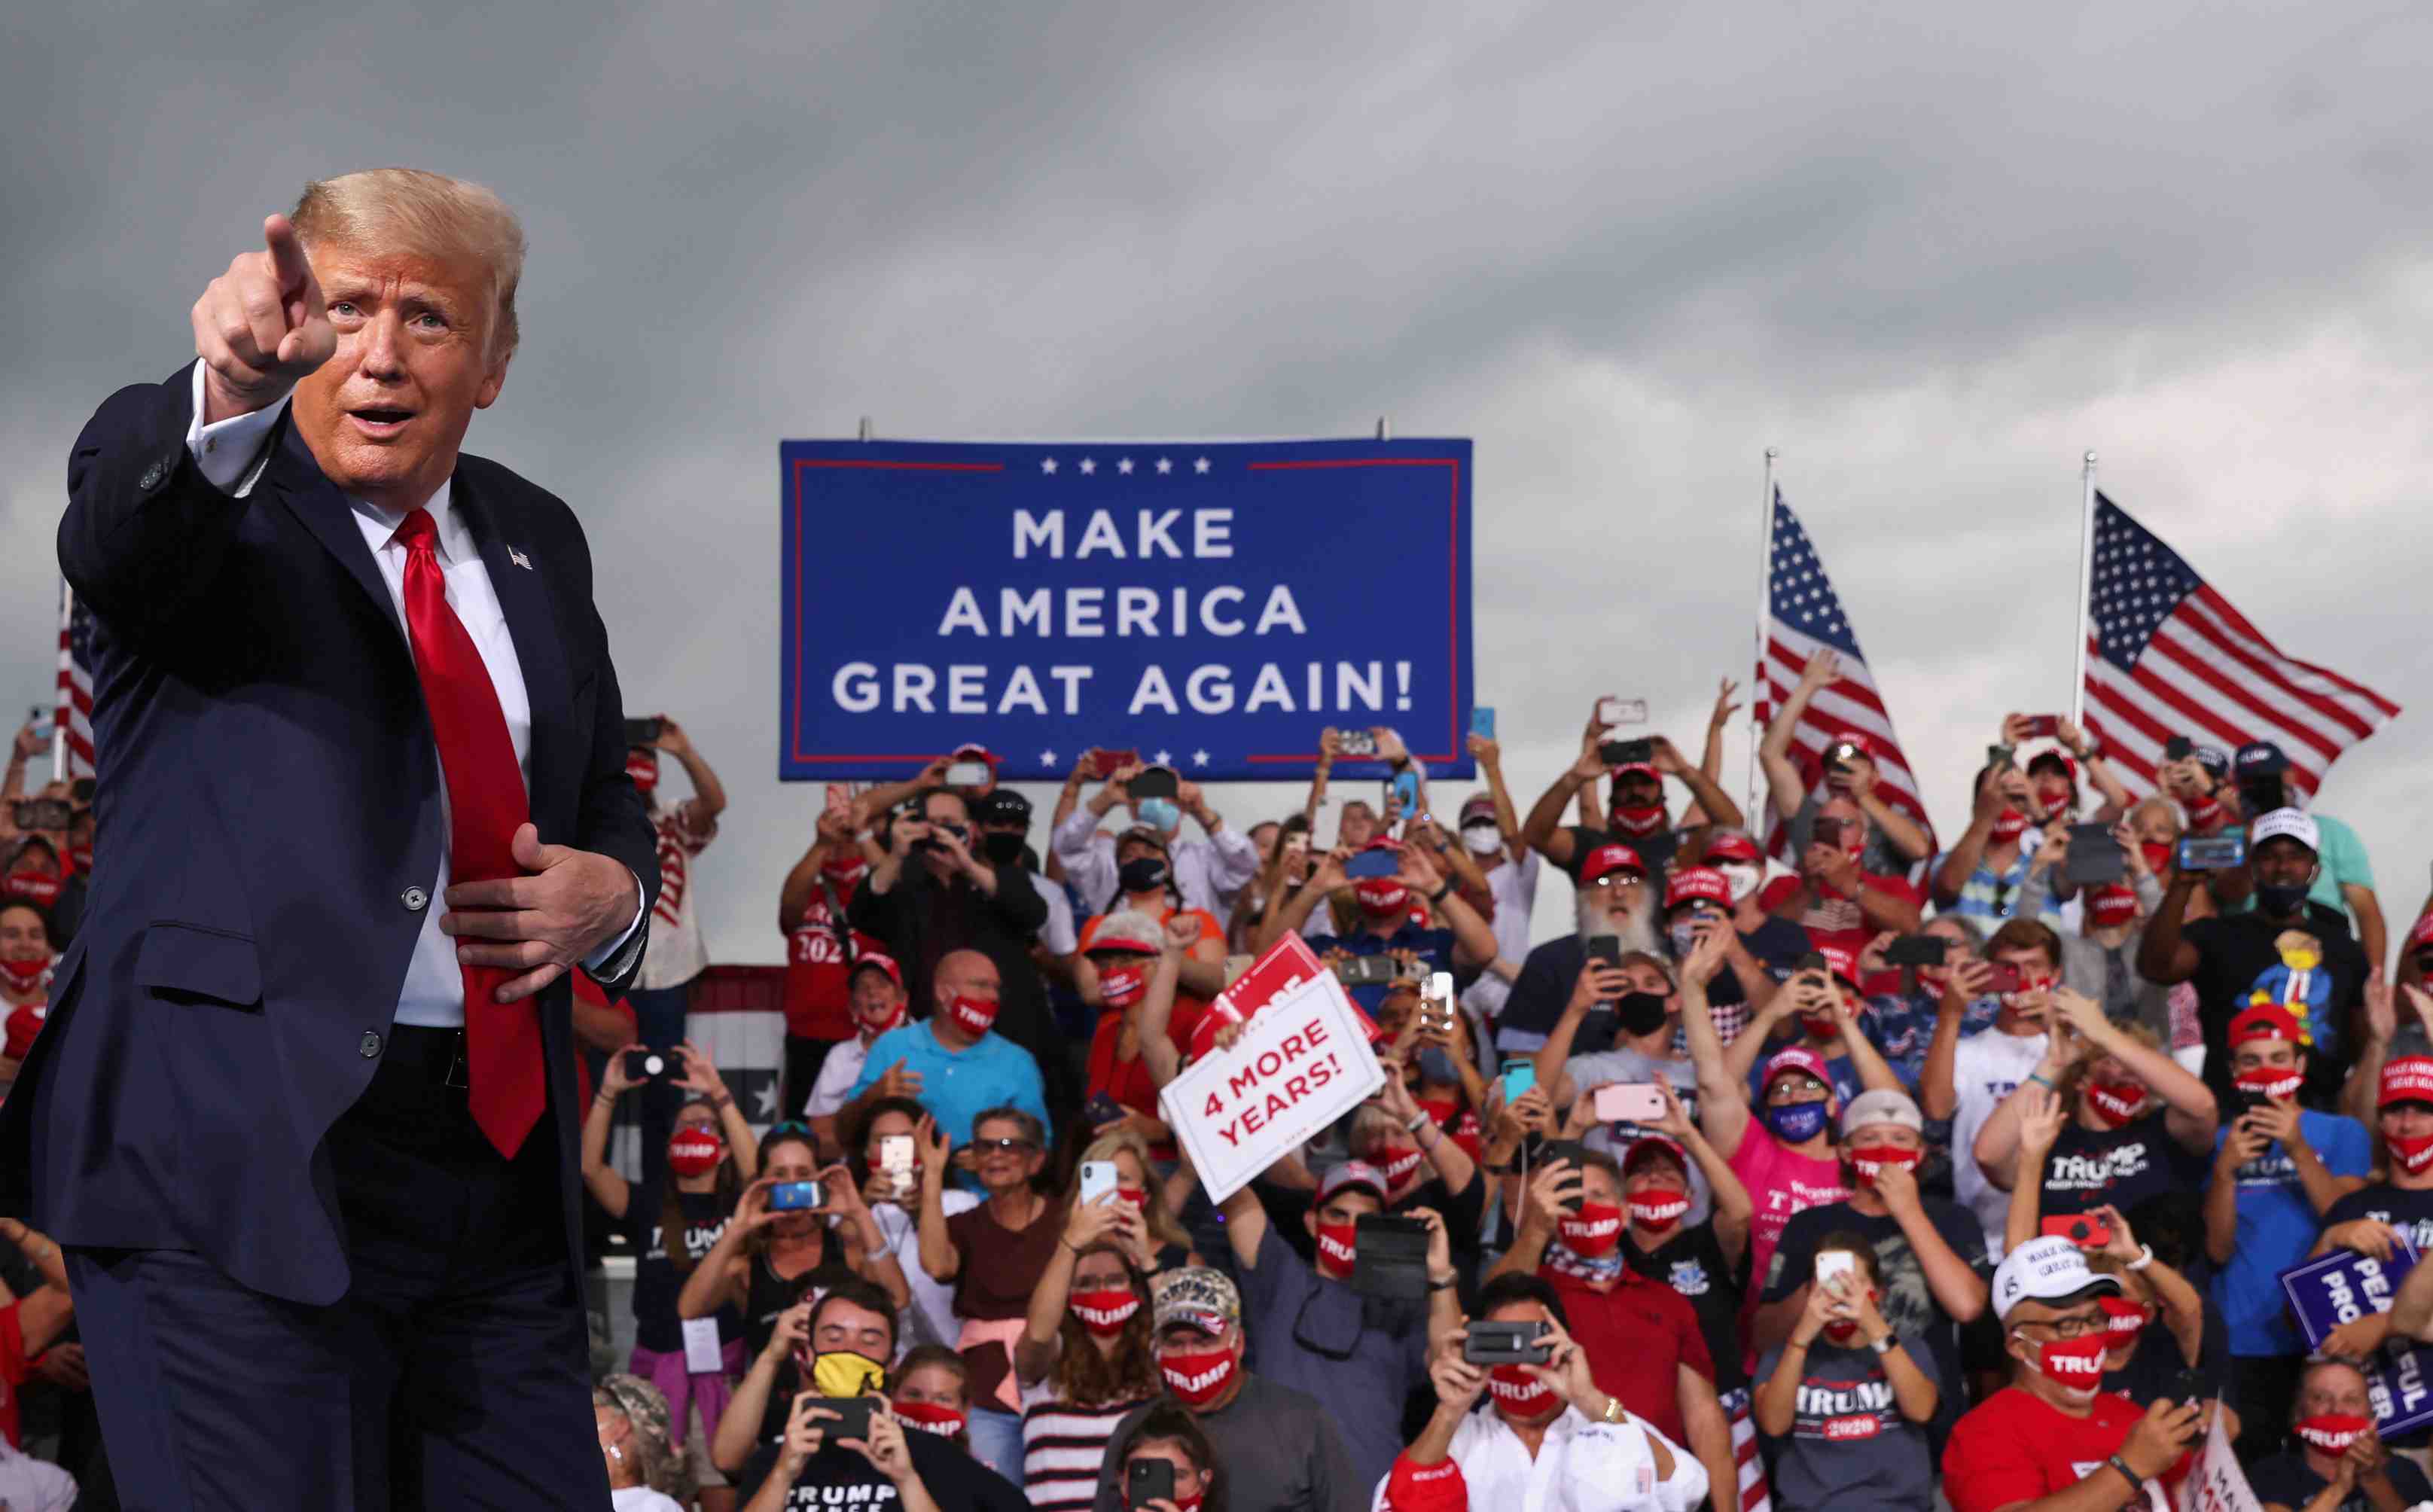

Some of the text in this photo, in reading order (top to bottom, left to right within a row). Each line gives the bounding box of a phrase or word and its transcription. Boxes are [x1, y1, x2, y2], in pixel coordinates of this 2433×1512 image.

[1014, 509, 1233, 558] MAKE
[938, 585, 1306, 636] AMERICA
[832, 660, 1411, 715] GREAT AGAIN!
[1204, 1019, 1330, 1117] 4 MORE
[1218, 1052, 1342, 1147] YEARS!
[2052, 1142, 2145, 1181] TRUMP
[1562, 1218, 1620, 1238] TRUMP
[1630, 1201, 1689, 1221] TRUMP
[1319, 1233, 1357, 1261] TRU
[1071, 1300, 1140, 1326] TRUMP
[1163, 1360, 1231, 1393] TRUMP
